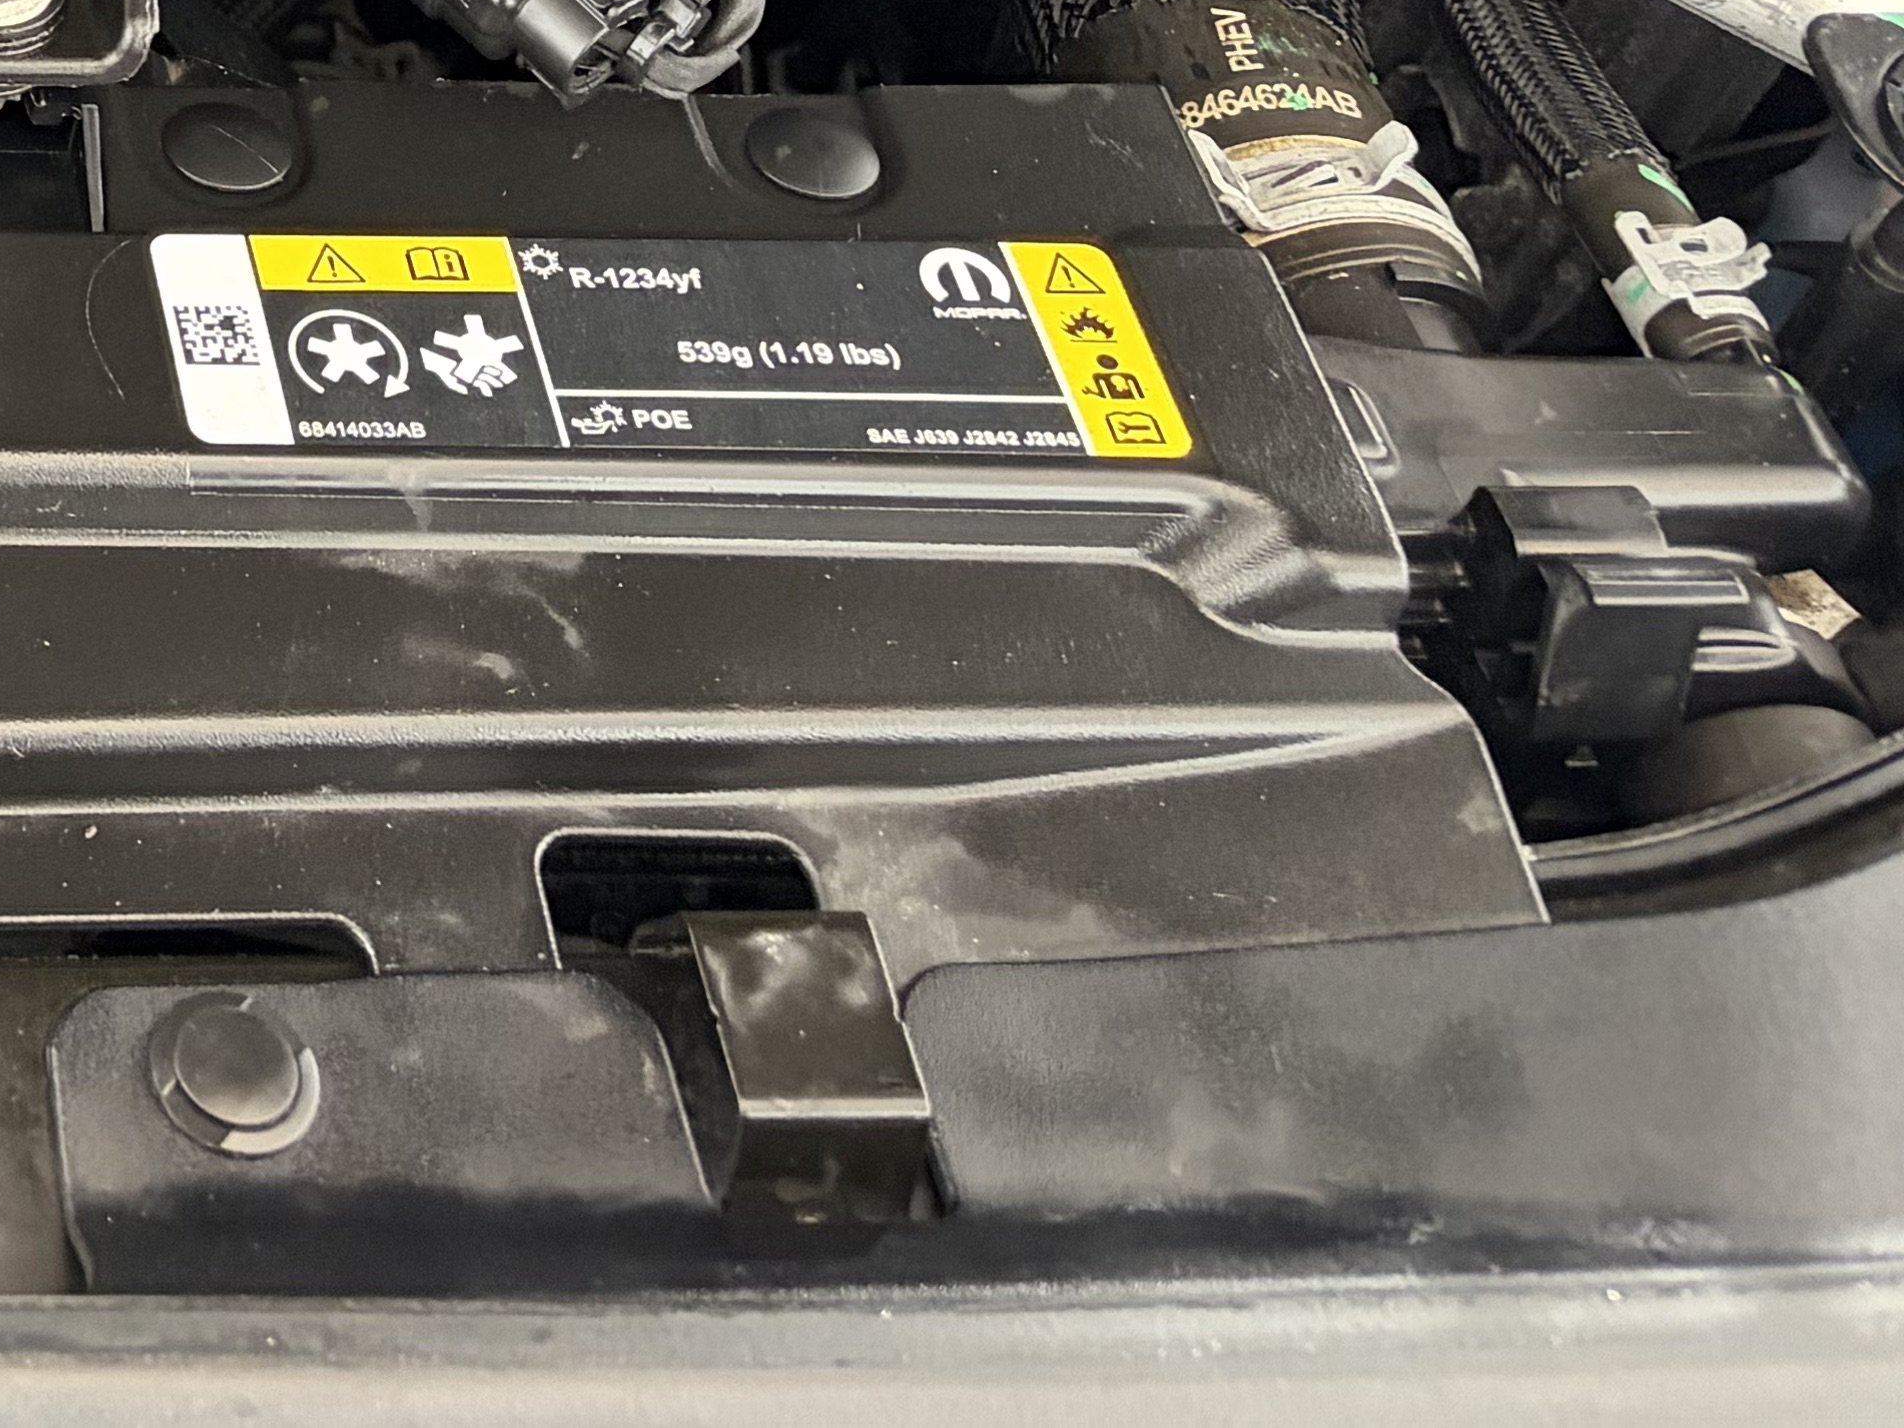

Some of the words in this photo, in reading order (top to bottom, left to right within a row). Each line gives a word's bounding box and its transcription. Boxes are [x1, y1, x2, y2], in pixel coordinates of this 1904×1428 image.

[1210, 7, 1264, 73] PHEV
[1178, 82, 1363, 131] 8464624AB
[569, 267, 704, 295] R-1234yf
[677, 340, 754, 369] 539g
[759, 340, 835, 369] (1.19
[838, 342, 902, 372] lbs)
[298, 420, 427, 439] 68414033AB
[632, 408, 693, 431] POE
[867, 428, 911, 445] SAE
[913, 429, 959, 446] J639
